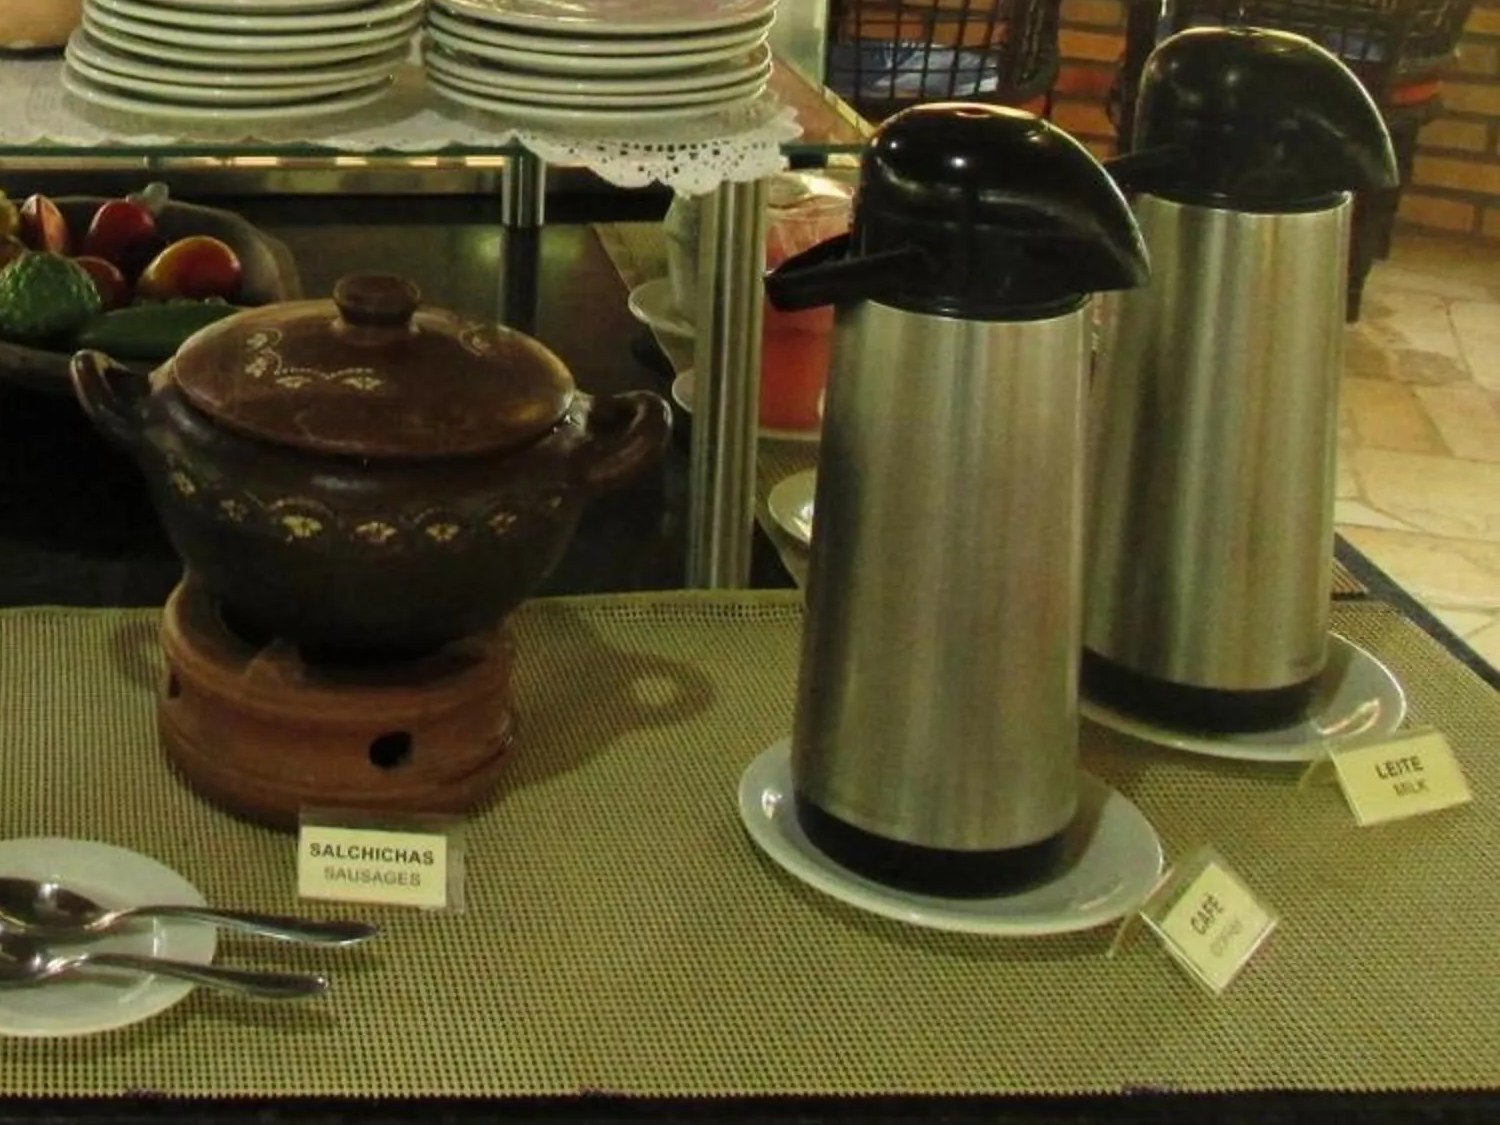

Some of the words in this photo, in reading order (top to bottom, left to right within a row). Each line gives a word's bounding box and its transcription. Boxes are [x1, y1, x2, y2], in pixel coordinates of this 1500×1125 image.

[1375, 755, 1424, 780] LEITE
[309, 842, 435, 866] SALCHICHAS
[324, 865, 422, 887] SAUSAGES
